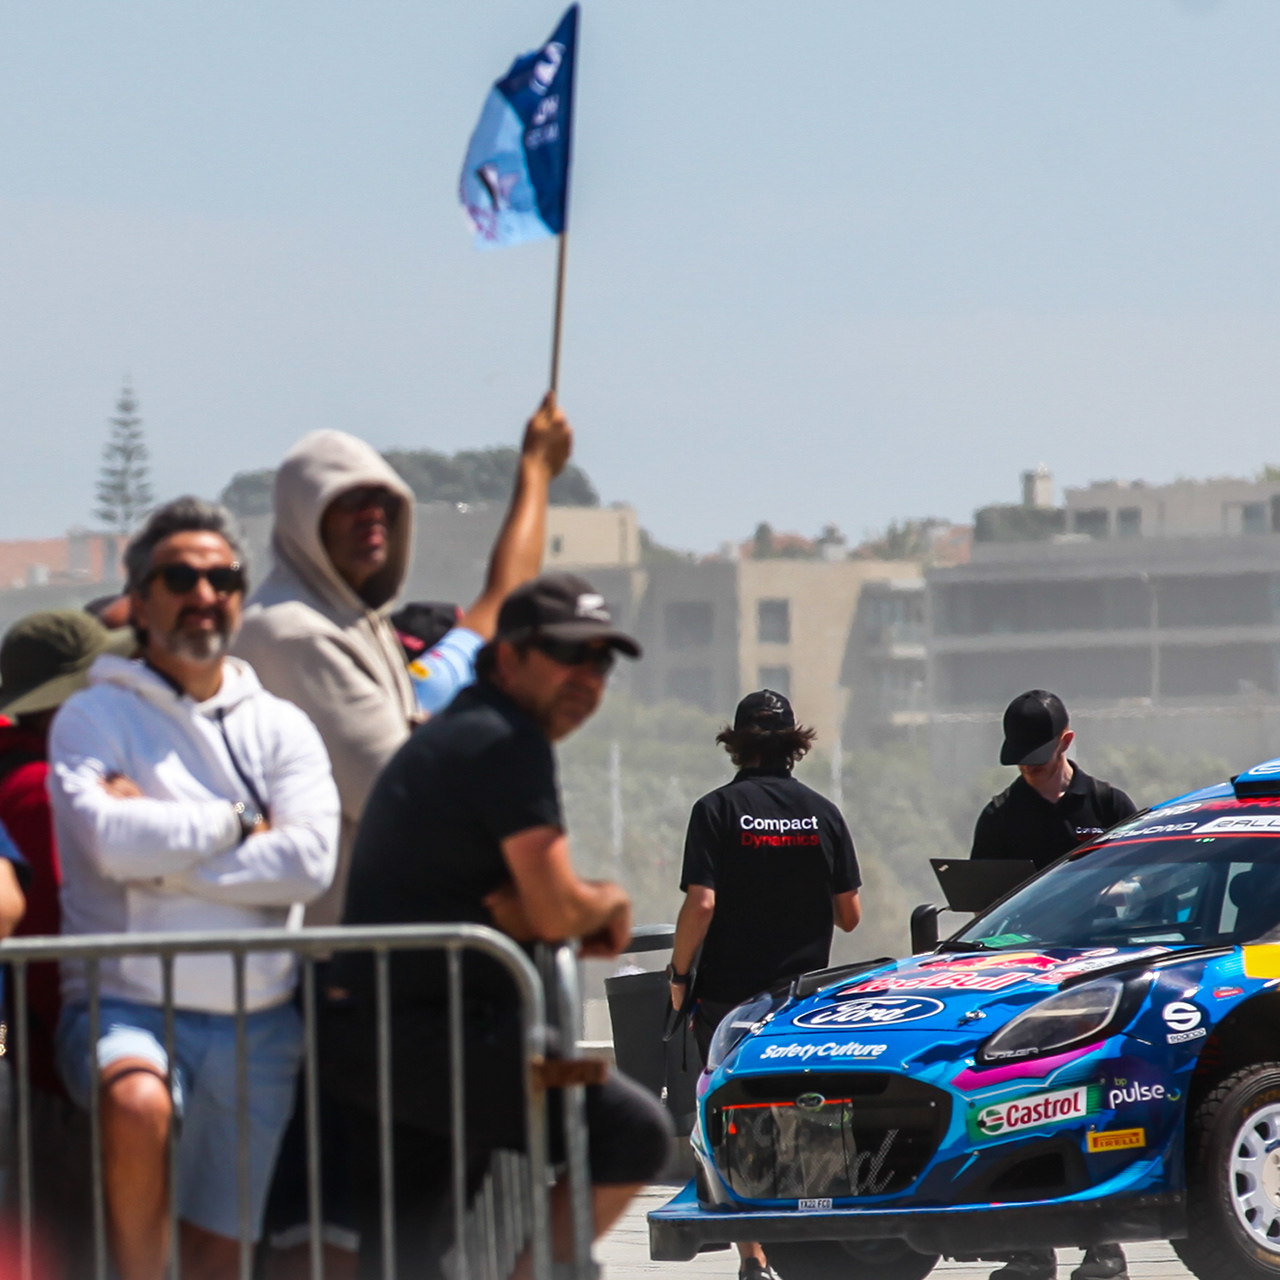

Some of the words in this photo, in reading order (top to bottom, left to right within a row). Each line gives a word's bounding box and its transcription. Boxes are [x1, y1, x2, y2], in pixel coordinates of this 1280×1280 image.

[740, 814, 819, 834] Compact
[741, 832, 819, 849] Dynamics
[810, 1000, 923, 1024] Ford
[760, 1041, 888, 1061] SafetyCulture
[1114, 1076, 1127, 1087] bp
[1108, 1081, 1166, 1110] pulse
[1006, 1091, 1082, 1128] Castrol
[1092, 1131, 1141, 1149] PIRELLI
